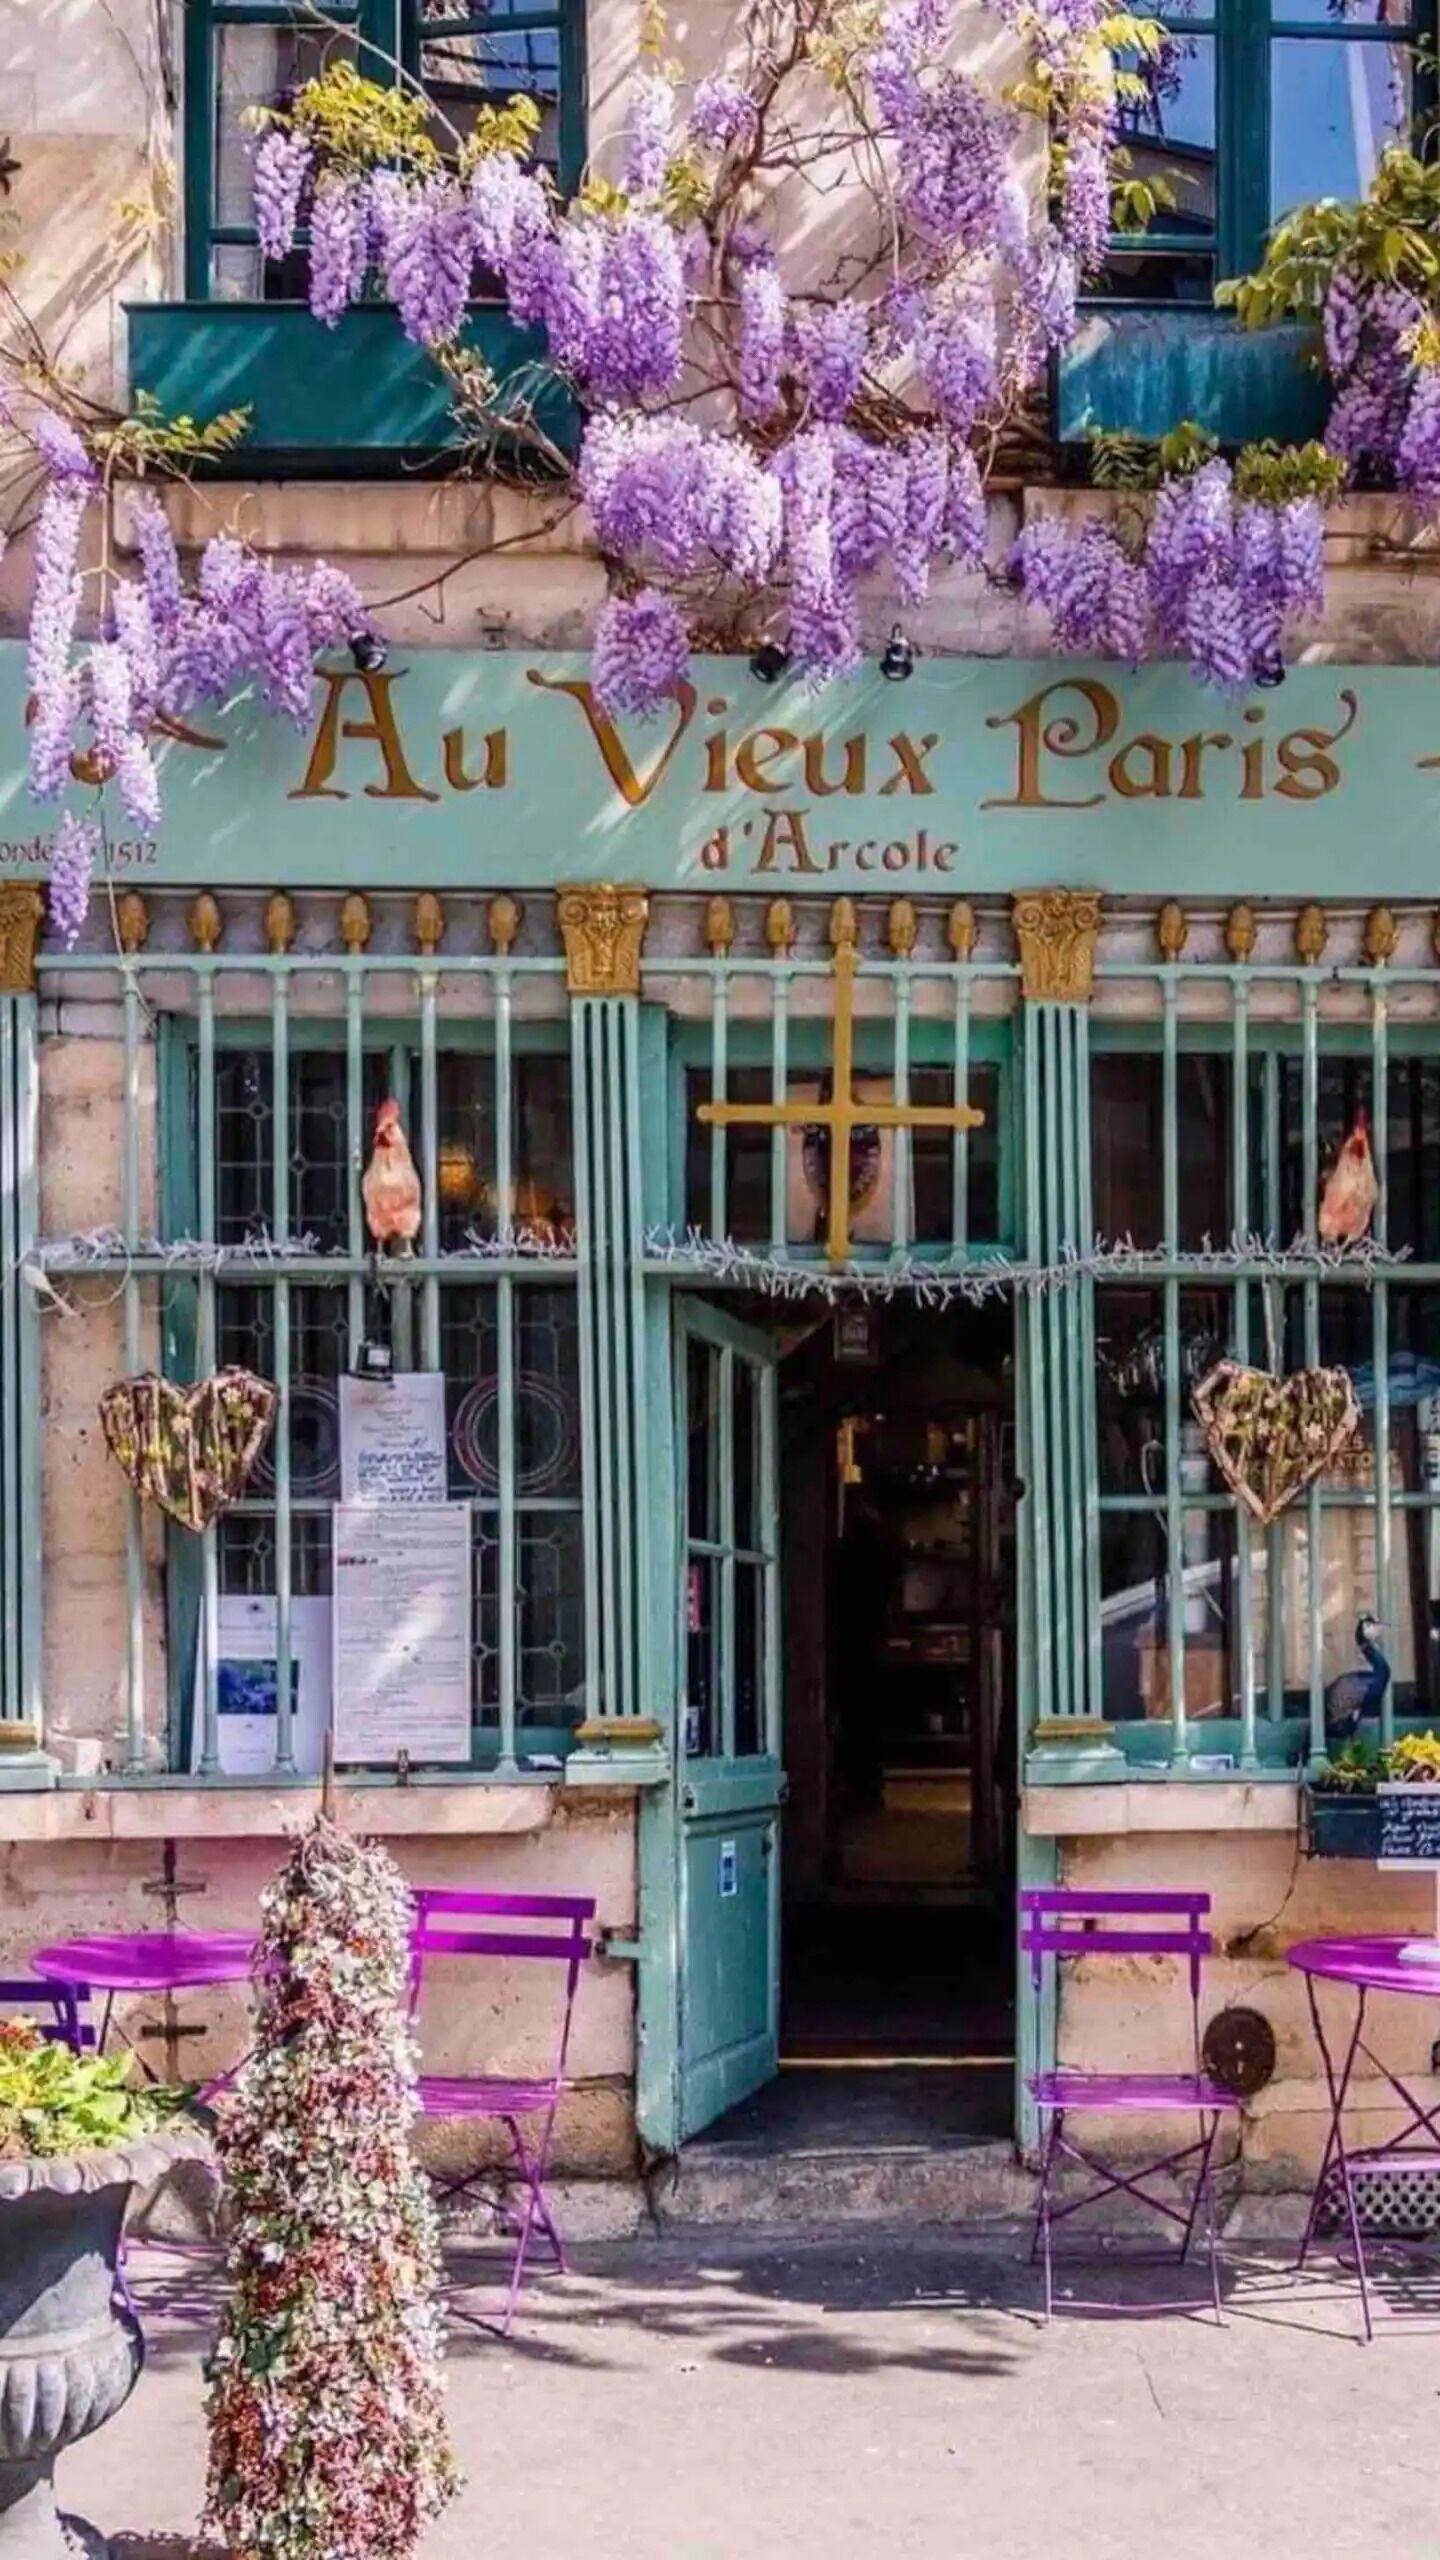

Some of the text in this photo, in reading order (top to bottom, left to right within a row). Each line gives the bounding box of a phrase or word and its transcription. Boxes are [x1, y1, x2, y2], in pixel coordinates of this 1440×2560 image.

[286, 666, 1357, 810] Au Vieux Paris
[108, 841, 157, 871] 1512
[701, 807, 960, 875] d'Arcole
